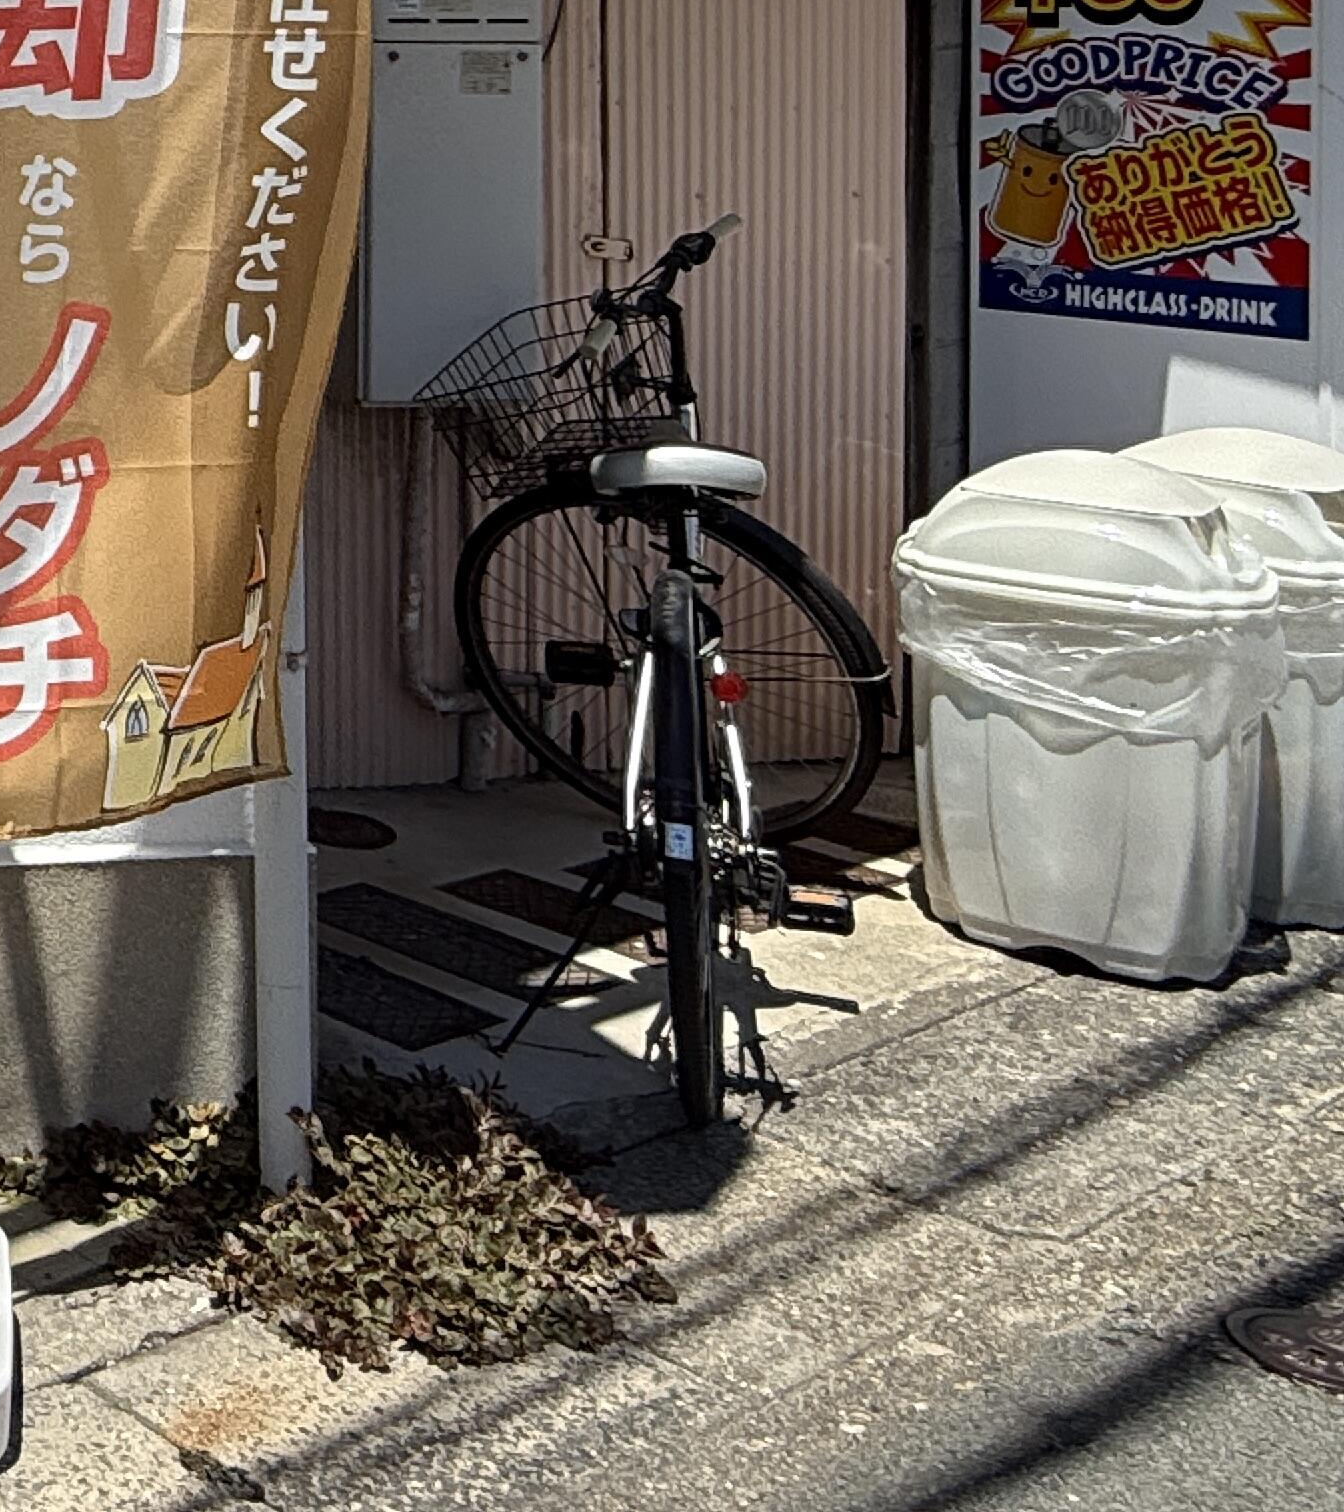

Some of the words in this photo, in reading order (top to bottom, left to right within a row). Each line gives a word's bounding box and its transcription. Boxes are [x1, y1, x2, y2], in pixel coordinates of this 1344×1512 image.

[1076, 119, 1274, 206] ありがとう
[18, 154, 78, 284] なら
